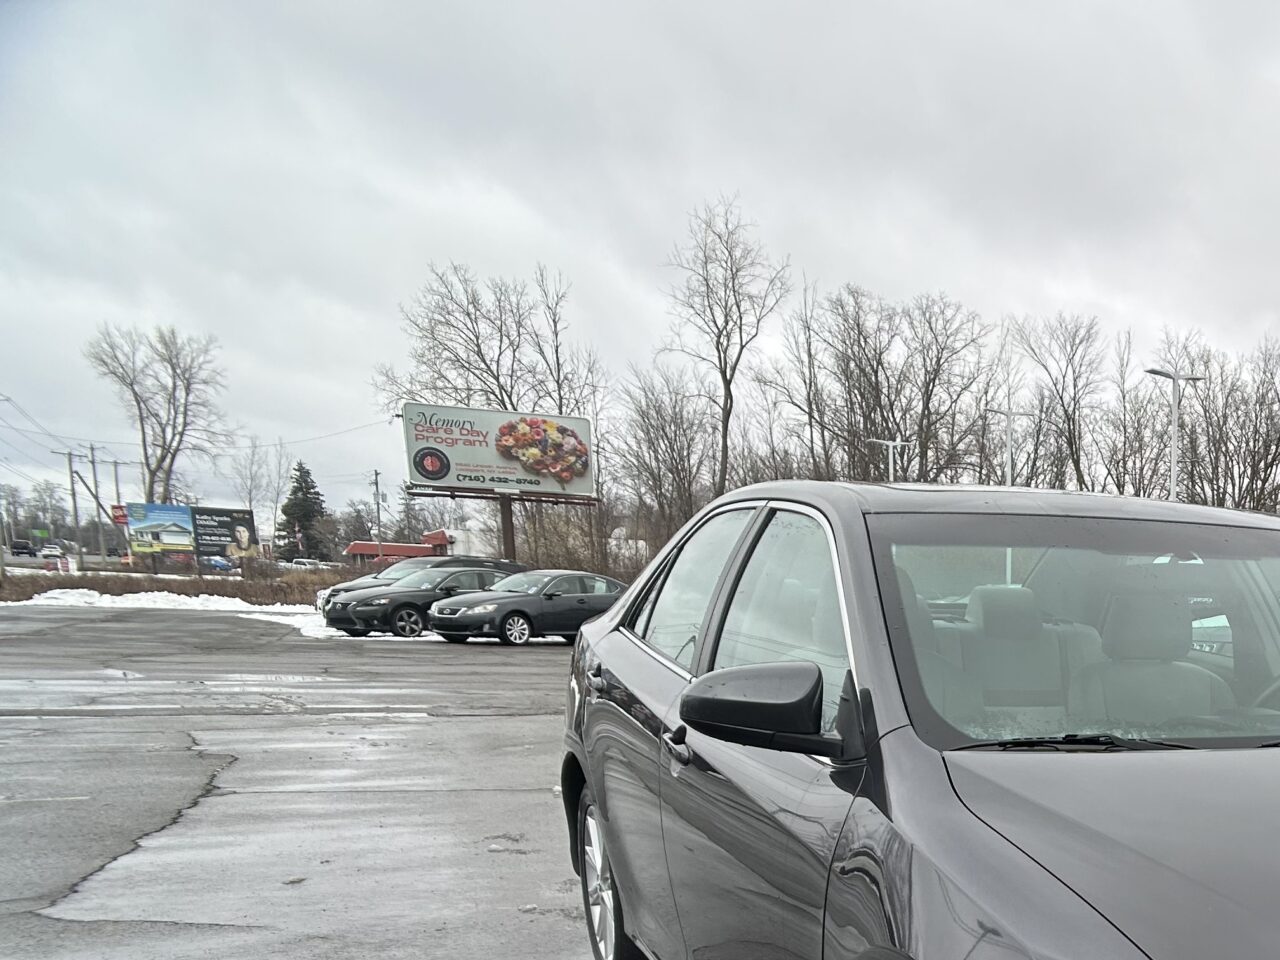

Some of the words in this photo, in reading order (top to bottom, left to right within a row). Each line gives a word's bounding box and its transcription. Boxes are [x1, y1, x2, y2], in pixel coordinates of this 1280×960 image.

[409, 412, 475, 430] Memory
[414, 424, 453, 434] Care
[459, 428, 489, 439] Day
[415, 433, 488, 447] Program
